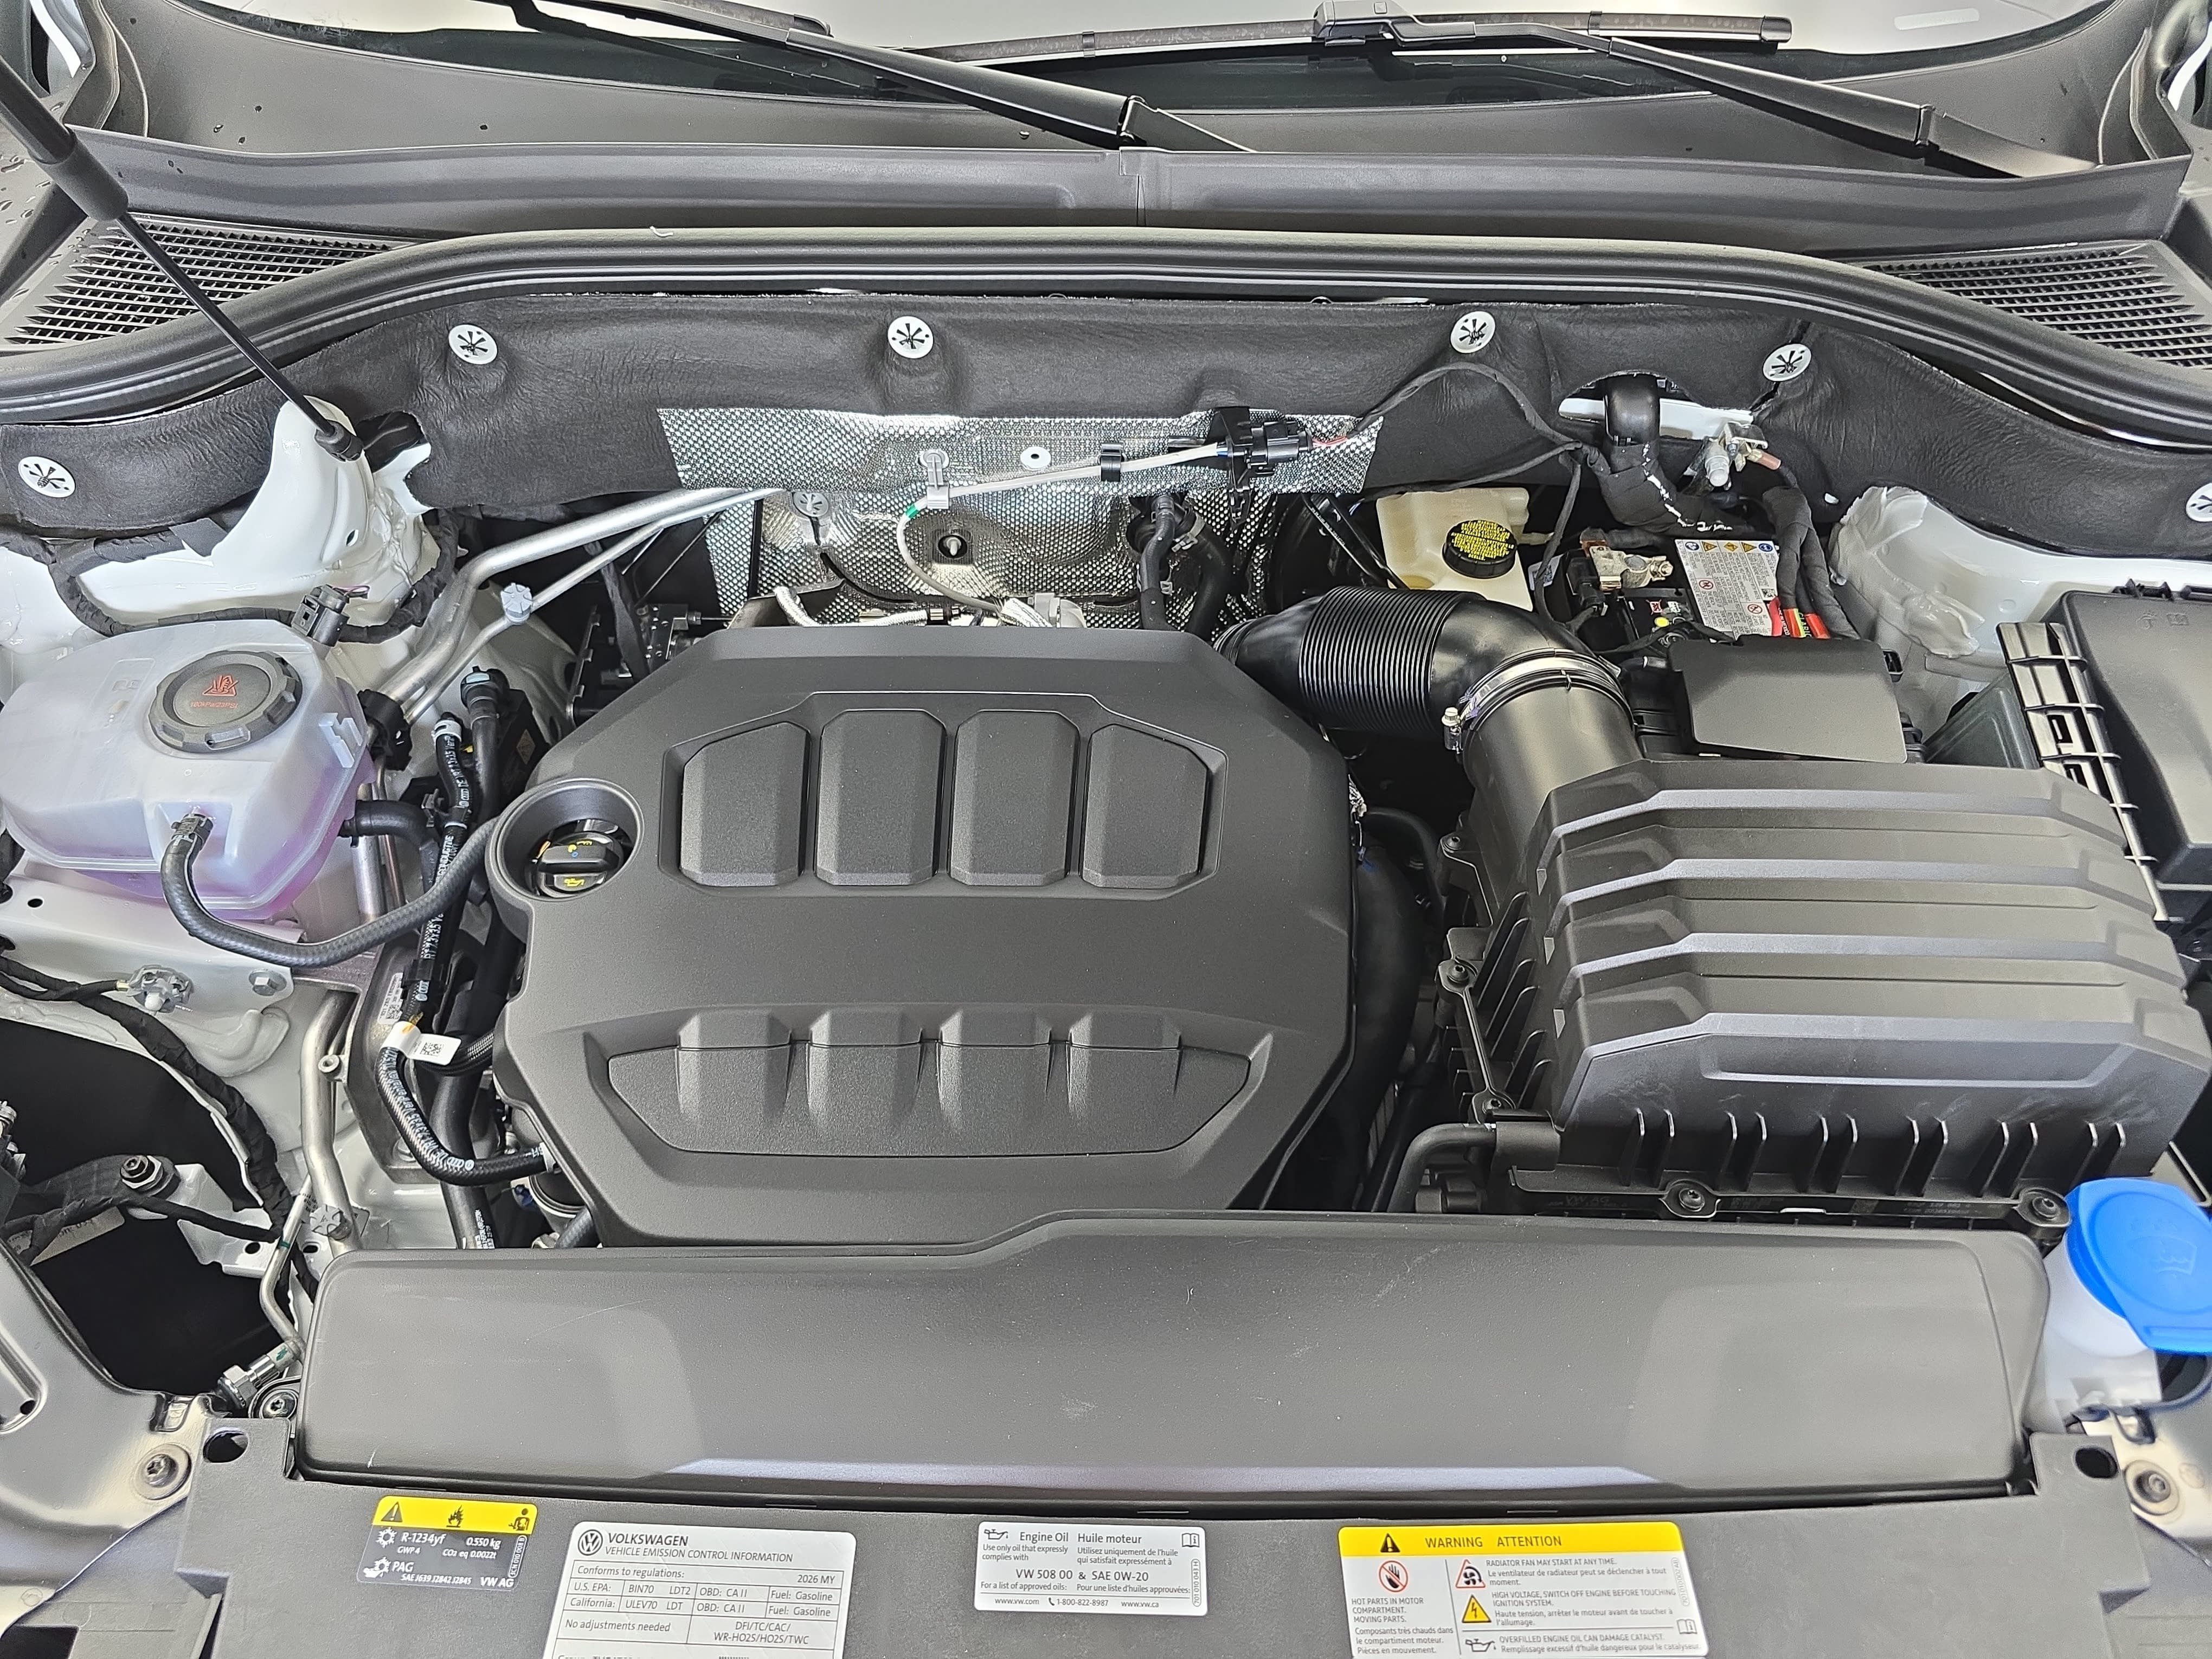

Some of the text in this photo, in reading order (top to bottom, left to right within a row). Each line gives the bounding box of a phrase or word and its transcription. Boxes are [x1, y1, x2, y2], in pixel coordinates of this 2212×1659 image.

[401, 1532, 446, 1546] R-1234yf
[466, 1537, 501, 1549] 0.550 kg
[608, 1532, 688, 1546] VOLKSWAGEN
[1020, 1532, 1068, 1544] Engine Oil
[1078, 1533, 1141, 1543] Huile moteur
[1425, 1536, 1483, 1547] WARNING
[1497, 1535, 1561, 1546] ATTENTION
[605, 1546, 793, 1561] VEHICLE EMISSION CONTROL INFORMATION
[996, 1544, 1011, 1553] only
[1037, 1545, 1068, 1554] expressly
[1104, 1547, 1146, 1557] uniquement
[469, 1550, 497, 1559] 0.0022t
[982, 1553, 1012, 1562] complies
[1077, 1556, 1088, 1565] qui
[1118, 1557, 1166, 1566] expressément
[391, 1561, 414, 1572] PAG
[577, 1565, 684, 1579] Conforms to regulations:
[1015, 1568, 1072, 1579] VW 508 00
[1078, 1571, 1086, 1579] &
[1091, 1571, 1148, 1581] SAE 0W-20
[400, 1573, 472, 1585] SAE J639 J2842 J2845
[480, 1577, 515, 1589] VW AG
[797, 1574, 835, 1584] 2026 MY
[574, 1582, 611, 1591] U.S. EPA:
[628, 1584, 654, 1593] BIN70
[669, 1586, 690, 1594] LDT2
[1019, 1582, 1051, 1591] approved
[1108, 1584, 1121, 1592] liste
[1122, 1584, 1148, 1592] d'huiles
[1149, 1585, 1192, 1594] approuvées:
[699, 1587, 747, 1597] OBD: CA II
[770, 1590, 832, 1600] Fuel: Gasoline
[570, 1597, 615, 1607] California:
[626, 1599, 657, 1609] ULEV70
[666, 1601, 683, 1610] LDT
[1057, 1598, 1108, 1606] 1-800-822-8987
[697, 1603, 744, 1612] OBD: CA II
[768, 1605, 831, 1616] Fuel: Gasoline
[565, 1619, 671, 1631] No adjustments needed
[735, 1621, 790, 1631] DFI/TC/CAC/
[1354, 1627, 1397, 1636] Composants
[713, 1632, 809, 1644] WR-HO2S/HO2S/TWC
[1364, 1636, 1414, 1645] compartiment
